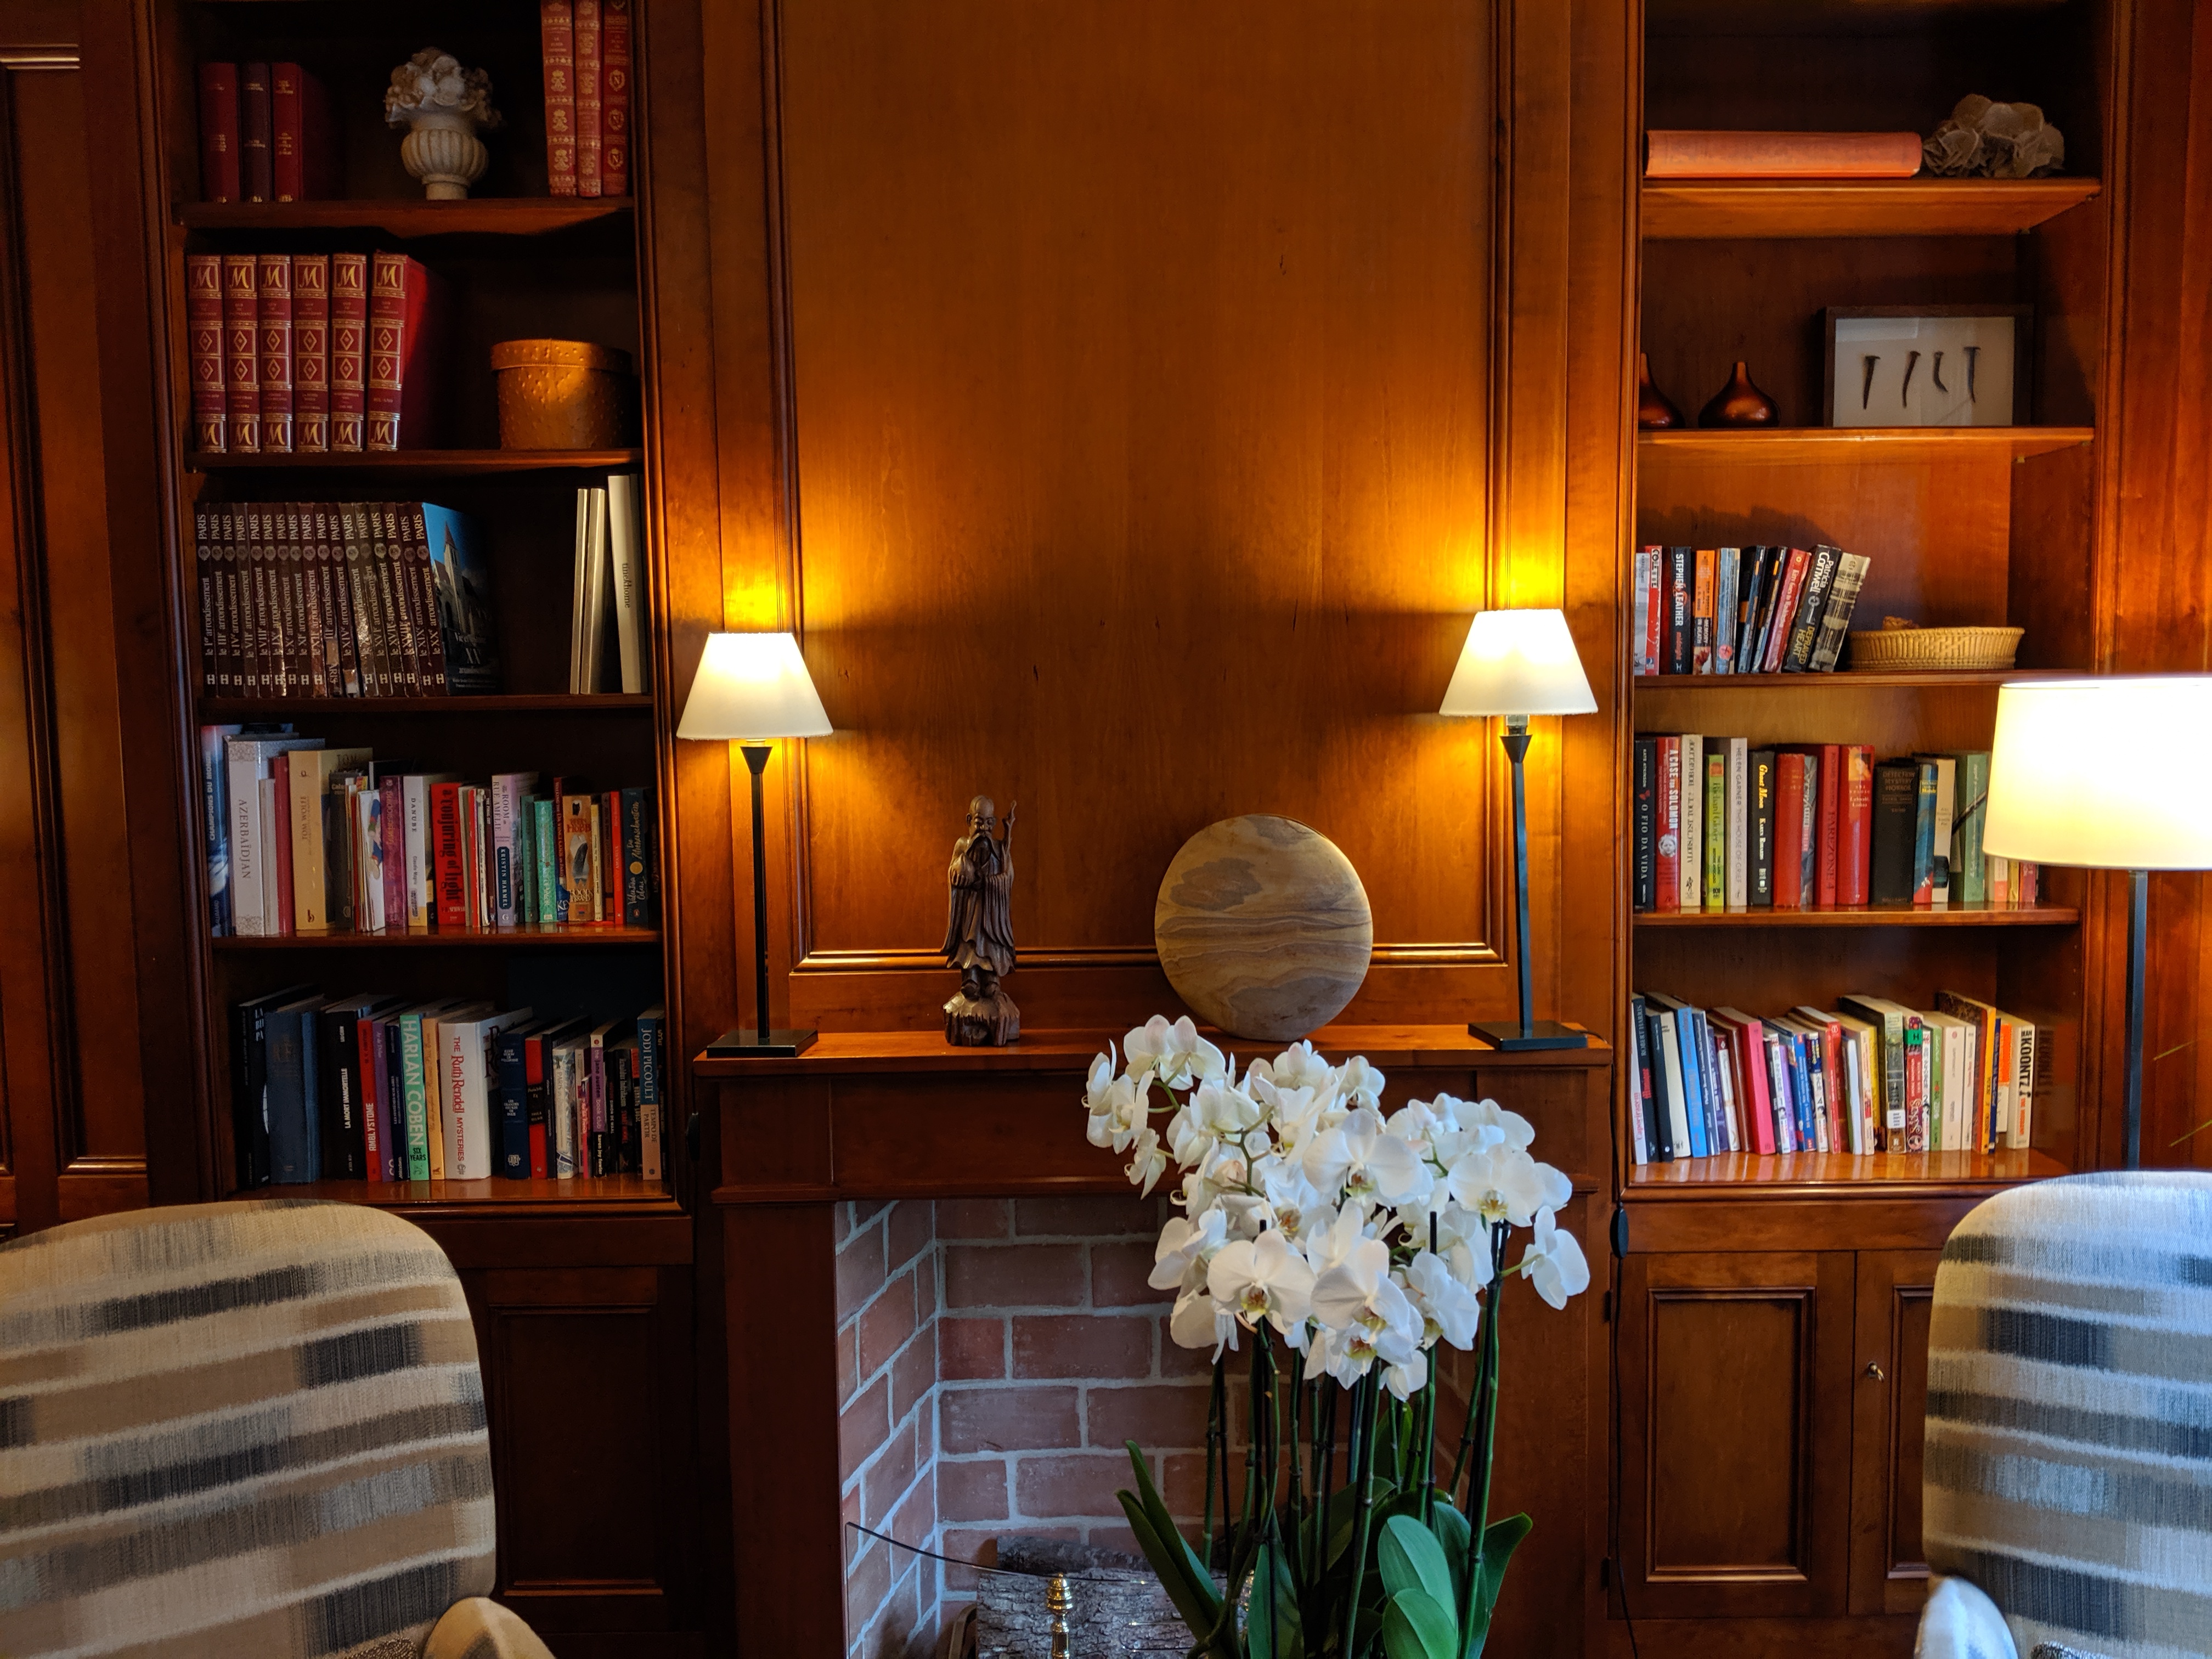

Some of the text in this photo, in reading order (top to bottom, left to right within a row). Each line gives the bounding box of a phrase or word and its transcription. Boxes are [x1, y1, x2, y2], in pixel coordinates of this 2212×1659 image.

[343, 515, 354, 540] PARIS
[198, 515, 213, 636] arrondissement PARIS
[211, 515, 224, 629] arrondissement PARIS
[223, 515, 239, 633] arrondissement PARIS
[236, 515, 252, 629] arrondissement PARIS
[250, 515, 266, 626] arrondissement PARIS
[263, 515, 279, 629] arrondissement PARIS
[276, 515, 294, 635] arrondissement PARIS
[289, 515, 306, 632] arrondissement PARIS
[302, 515, 318, 627] arrondissement PARIS
[317, 514, 332, 625] arrondissement PARIS
[330, 515, 349, 625] arrondissement PARIS
[358, 514, 379, 625] arrondissement PARIS
[372, 512, 393, 621] arrondissement PARIS
[386, 514, 407, 620] arrondissement PARIS
[401, 516, 422, 625] arrondissement PARIS
[414, 515, 436, 627] arrondissement PARIS
[1675, 554, 1684, 590] STEPHEN
[1809, 552, 1830, 593] Cornwell
[1819, 558, 1834, 589] Patricia
[1675, 592, 1683, 626] LEATHER
[1792, 628, 1808, 657] HEART
[1798, 625, 1813, 664] DEPRAVED
[207, 782, 213, 792] DU
[1669, 757, 1677, 778] CASE
[1759, 764, 1768, 809] Ghost Moon
[207, 795, 216, 841] CHAMPIONS
[437, 798, 459, 857] conjuring
[499, 794, 510, 819] ROOM
[556, 813, 562, 822] DA
[567, 824, 591, 832] HOBB
[1669, 789, 1678, 829] SOLOMON
[1711, 816, 1720, 842] Glover
[239, 799, 251, 879] AZERBAÏDJAN
[1641, 838, 1647, 850] DA
[1736, 850, 1742, 861] OF
[1827, 812, 1835, 880] FAREZONE
[441, 872, 462, 901] light
[447, 860, 458, 868] of
[627, 877, 637, 905] Valentina
[402, 1019, 424, 1146] HARLAN COBEN
[451, 1055, 464, 1077] Ruth
[641, 1028, 653, 1101] JODI PICOULT
[2019, 1037, 2032, 1088] KOONTZ
[452, 1080, 464, 1113] Rendell
[365, 1103, 376, 1151] AMBLYSTOME
[651, 1135, 657, 1143] DE
